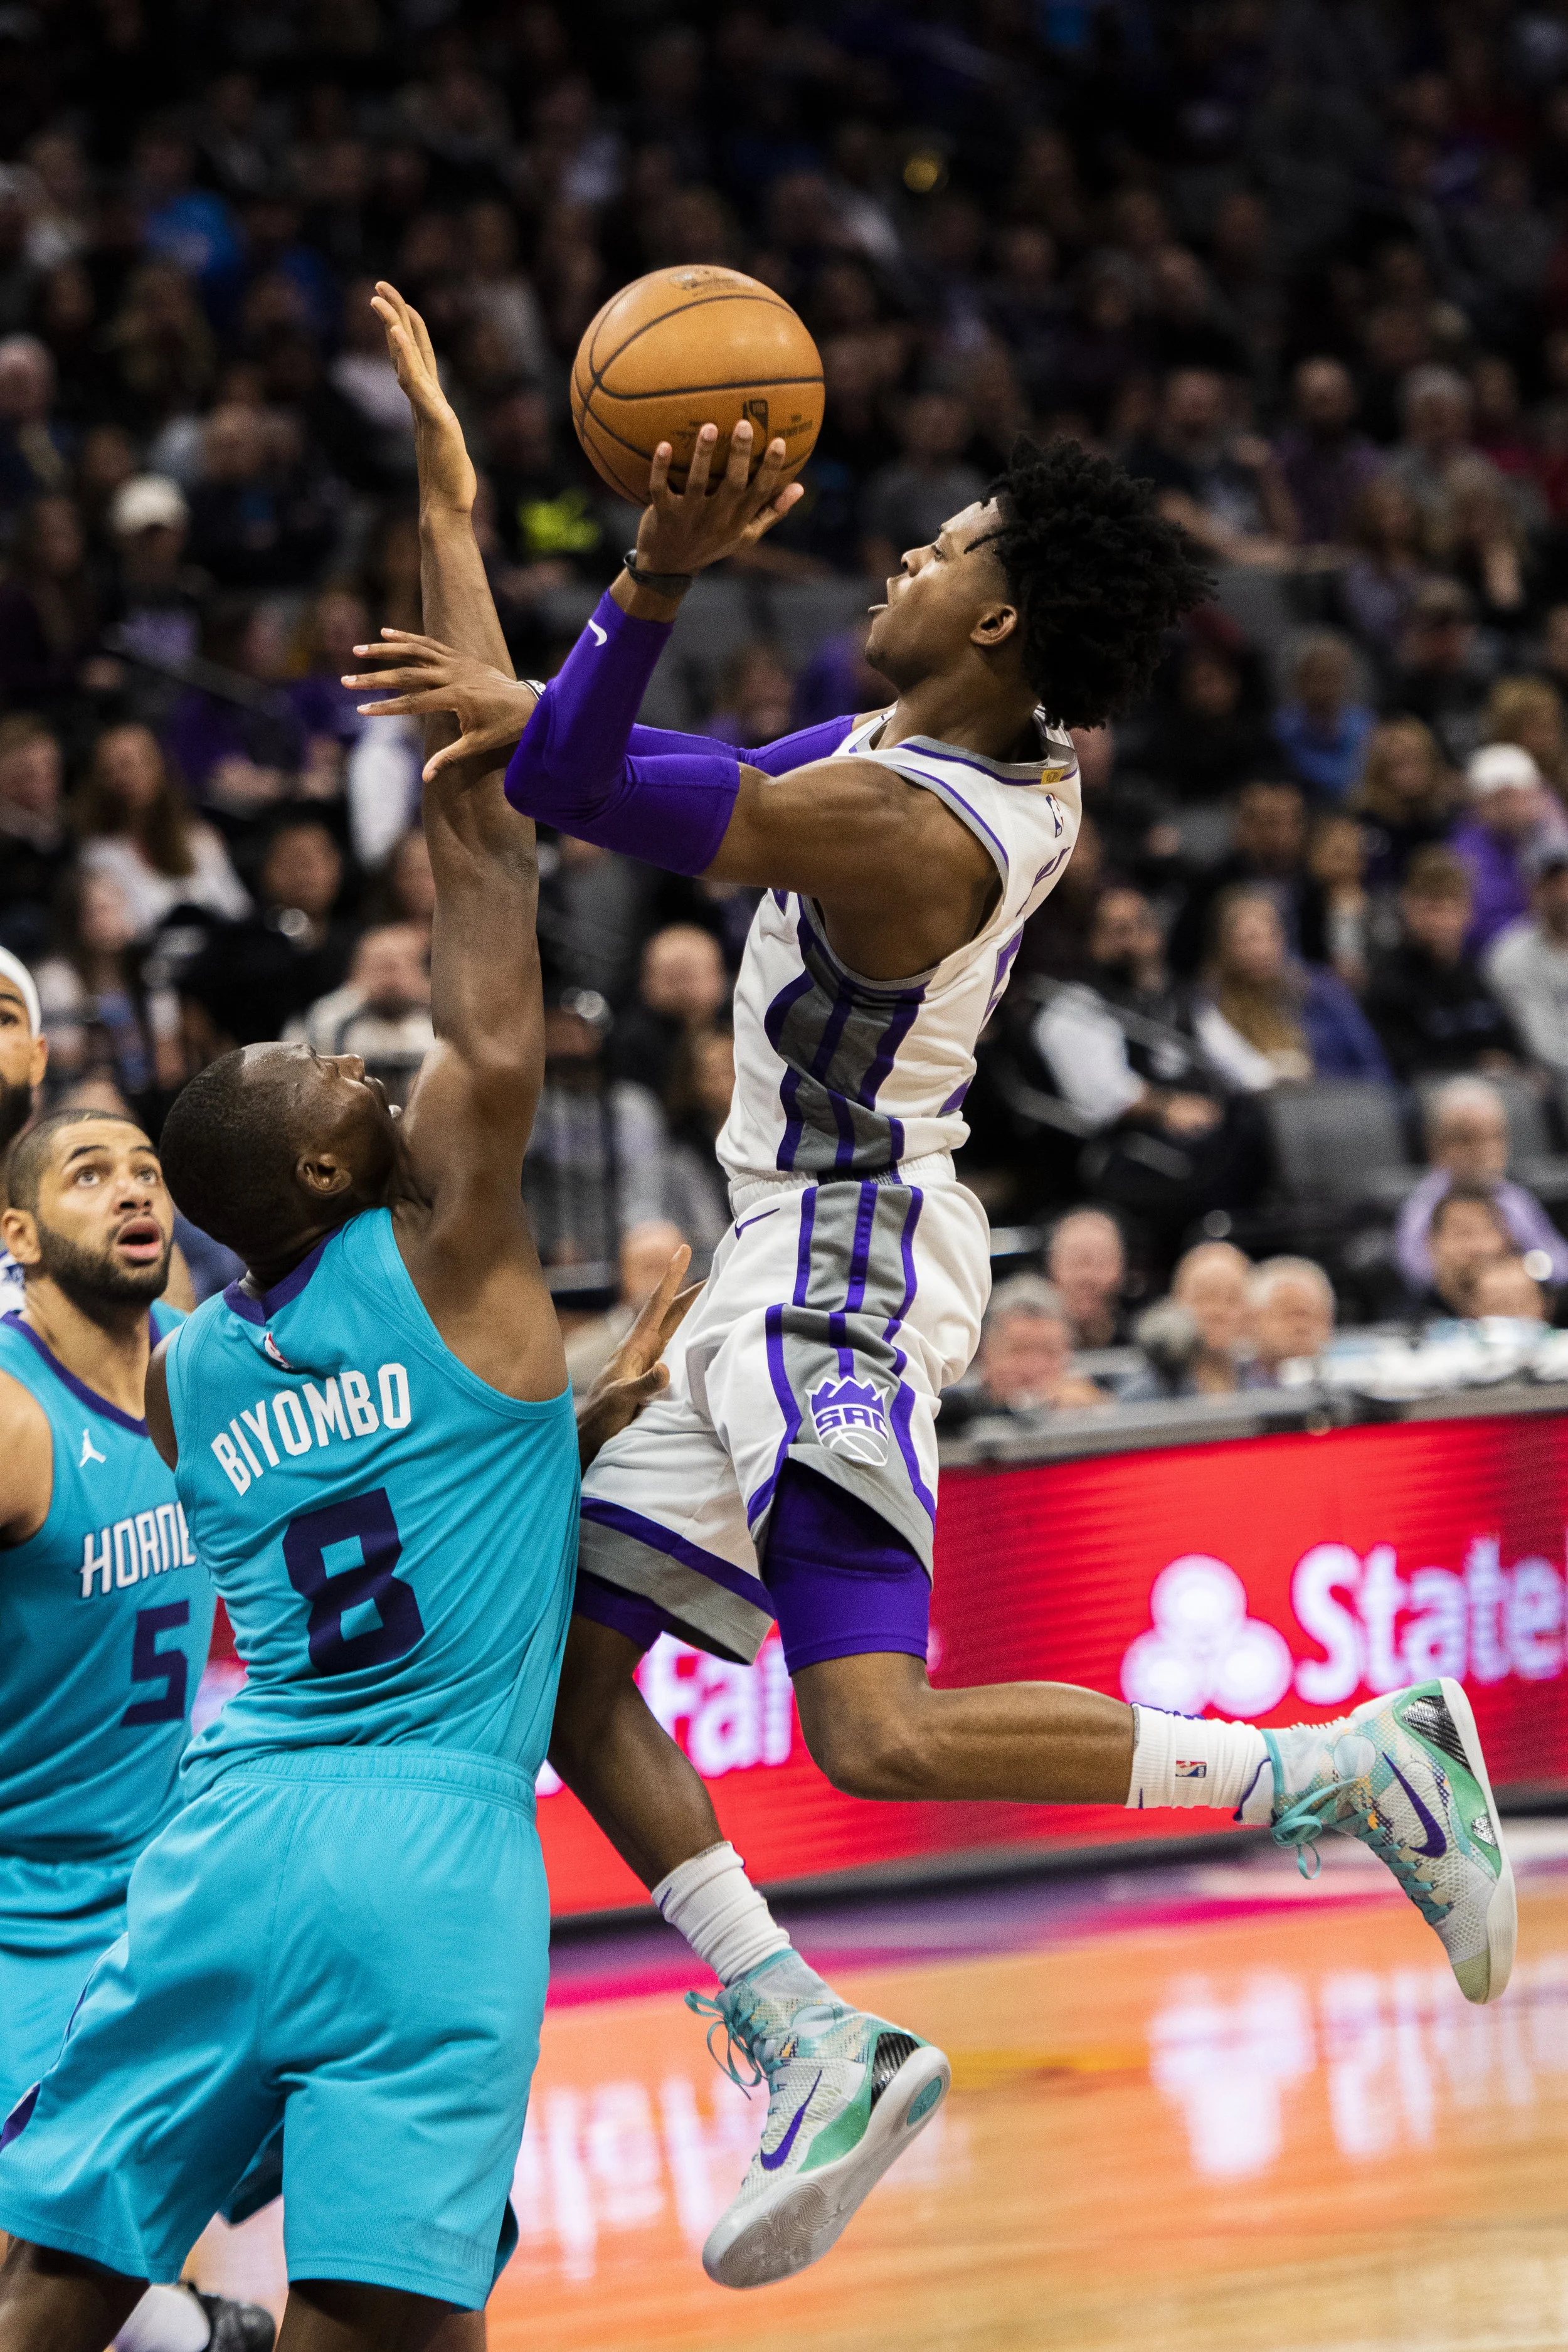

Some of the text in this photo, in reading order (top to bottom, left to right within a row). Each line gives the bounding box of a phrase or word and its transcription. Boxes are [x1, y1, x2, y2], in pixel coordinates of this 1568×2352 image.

[211, 1363, 411, 1496] BIYOMBO
[282, 1487, 426, 1677] 8
[1291, 1532, 1564, 1706] State
[120, 1601, 190, 1728] 5
